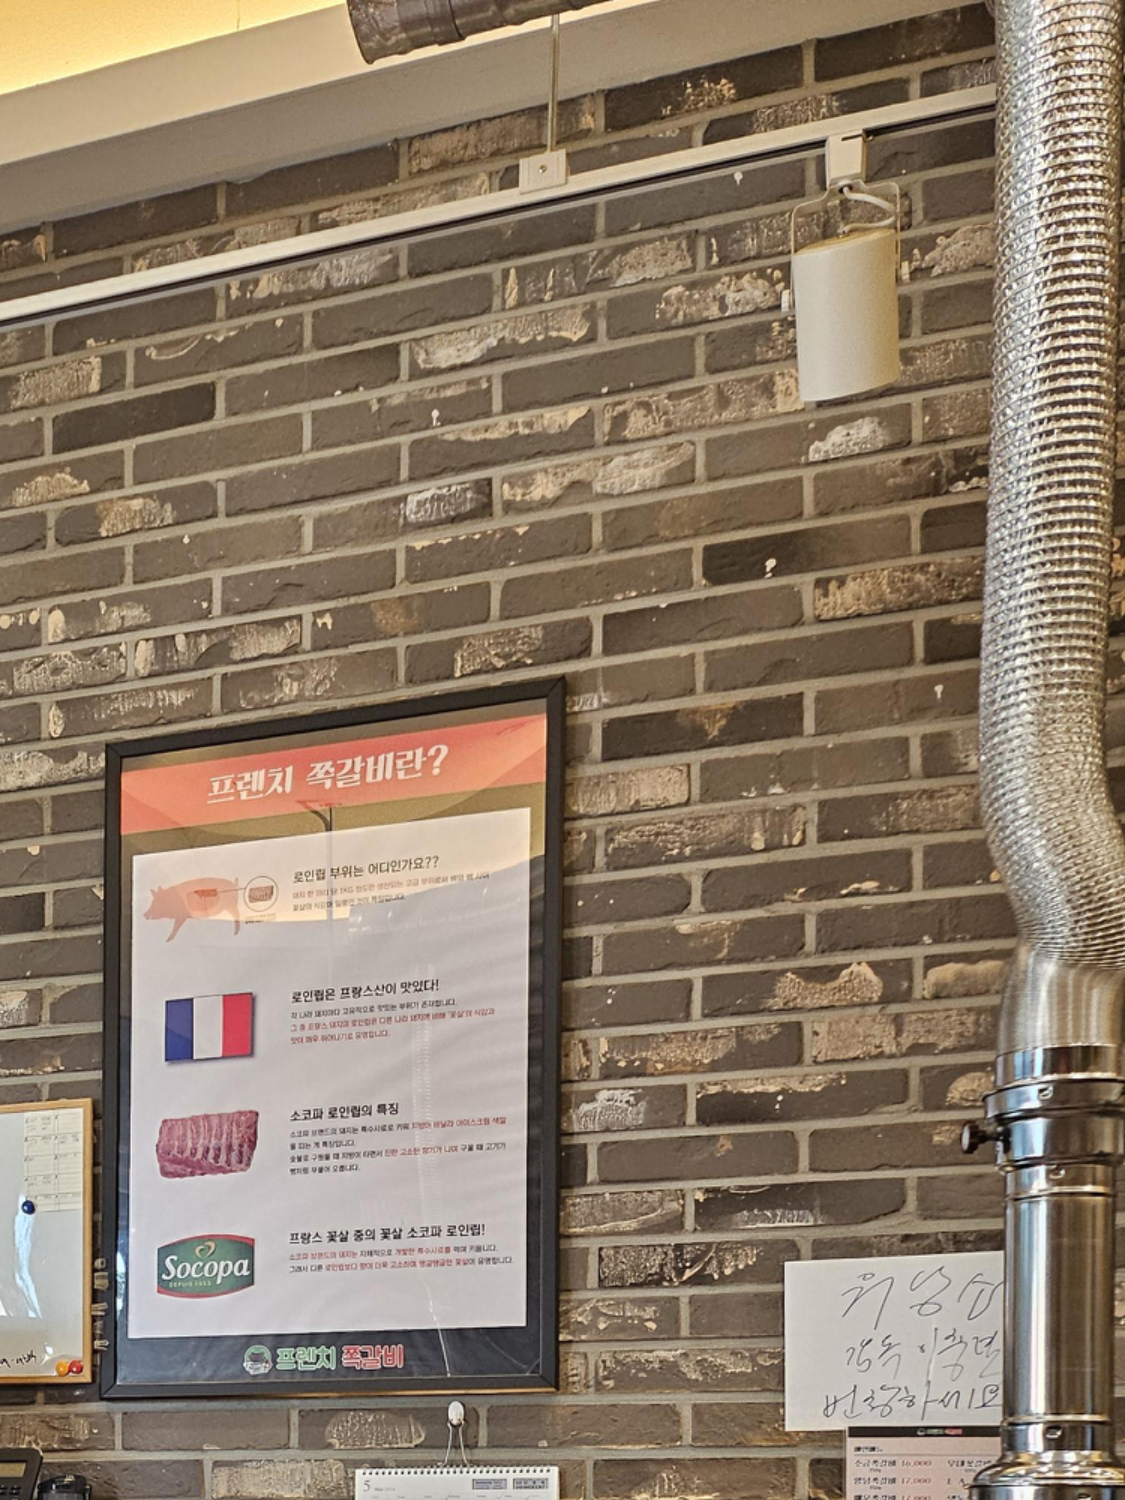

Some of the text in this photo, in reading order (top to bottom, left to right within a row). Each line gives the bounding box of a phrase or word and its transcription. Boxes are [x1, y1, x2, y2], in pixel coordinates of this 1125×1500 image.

[207, 745, 449, 805] 프렌치 쪽갈비란?
[330, 865, 364, 880] 부위는
[368, 855, 439, 875] 어디인가요??
[339, 982, 397, 1000] 프랑스산이
[400, 979, 439, 994] 맛있다!
[299, 1010, 312, 1018] 나라
[377, 1004, 397, 1012] 맛있는
[307, 1022, 328, 1031] 프랑스
[379, 1016, 392, 1025] 다른
[394, 1015, 408, 1023] 나라
[290, 1108, 324, 1121] 소코파
[377, 1102, 399, 1116] 특징
[290, 1130, 309, 1138] 소코파
[339, 1126, 359, 1135] 돼지는
[361, 1124, 394, 1133] 특수사료로
[456, 1117, 490, 1127] 아이스크림
[485, 1142, 506, 1151] 고기가
[289, 1232, 322, 1244] 프랑스
[327, 1230, 349, 1243] 꽃살
[354, 1228, 376, 1242] 중의
[380, 1227, 403, 1241] 꽃살
[407, 1226, 442, 1239] 소코파
[162, 1255, 251, 1285] Socopa
[289, 1265, 308, 1273] 그래서
[310, 1264, 323, 1272] 다른
[276, 1344, 404, 1371] 프렌치 쪽갈비
[901, 1459, 932, 1468] 16,000
[363, 1480, 371, 1492] 5
[901, 1477, 932, 1485] 17,000
